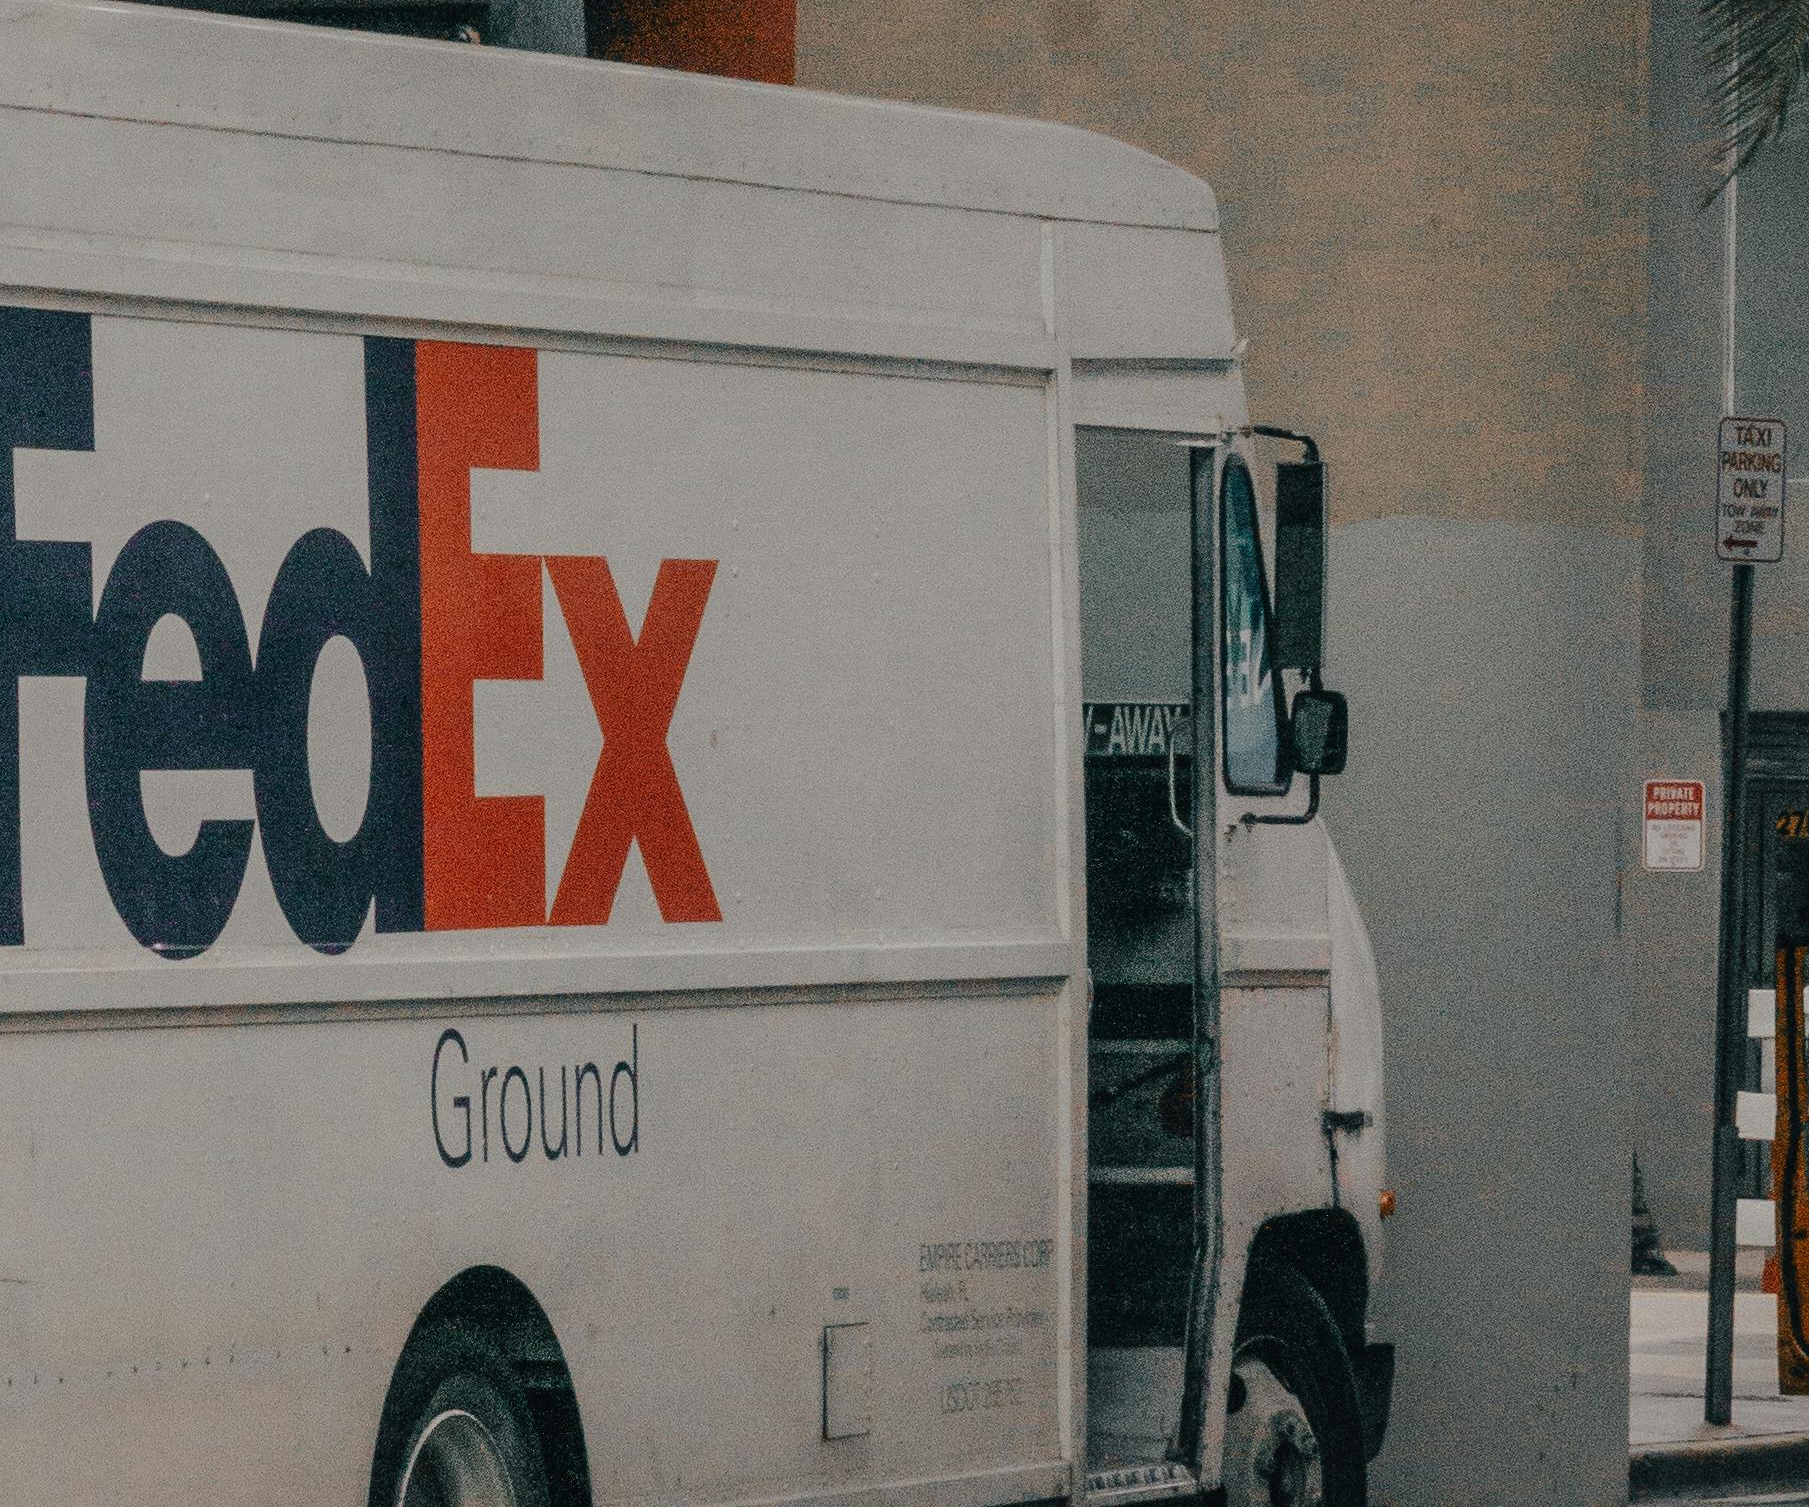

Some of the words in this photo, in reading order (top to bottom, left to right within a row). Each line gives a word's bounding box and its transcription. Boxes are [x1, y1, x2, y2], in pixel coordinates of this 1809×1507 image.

[1734, 426, 1773, 446] TAXI
[1722, 451, 1782, 473] PARKING
[1732, 478, 1769, 498] ONLY
[1652, 786, 1696, 800] PRIVATE
[1647, 801, 1701, 816] PROPERTY
[431, 1023, 639, 1168] Ground
